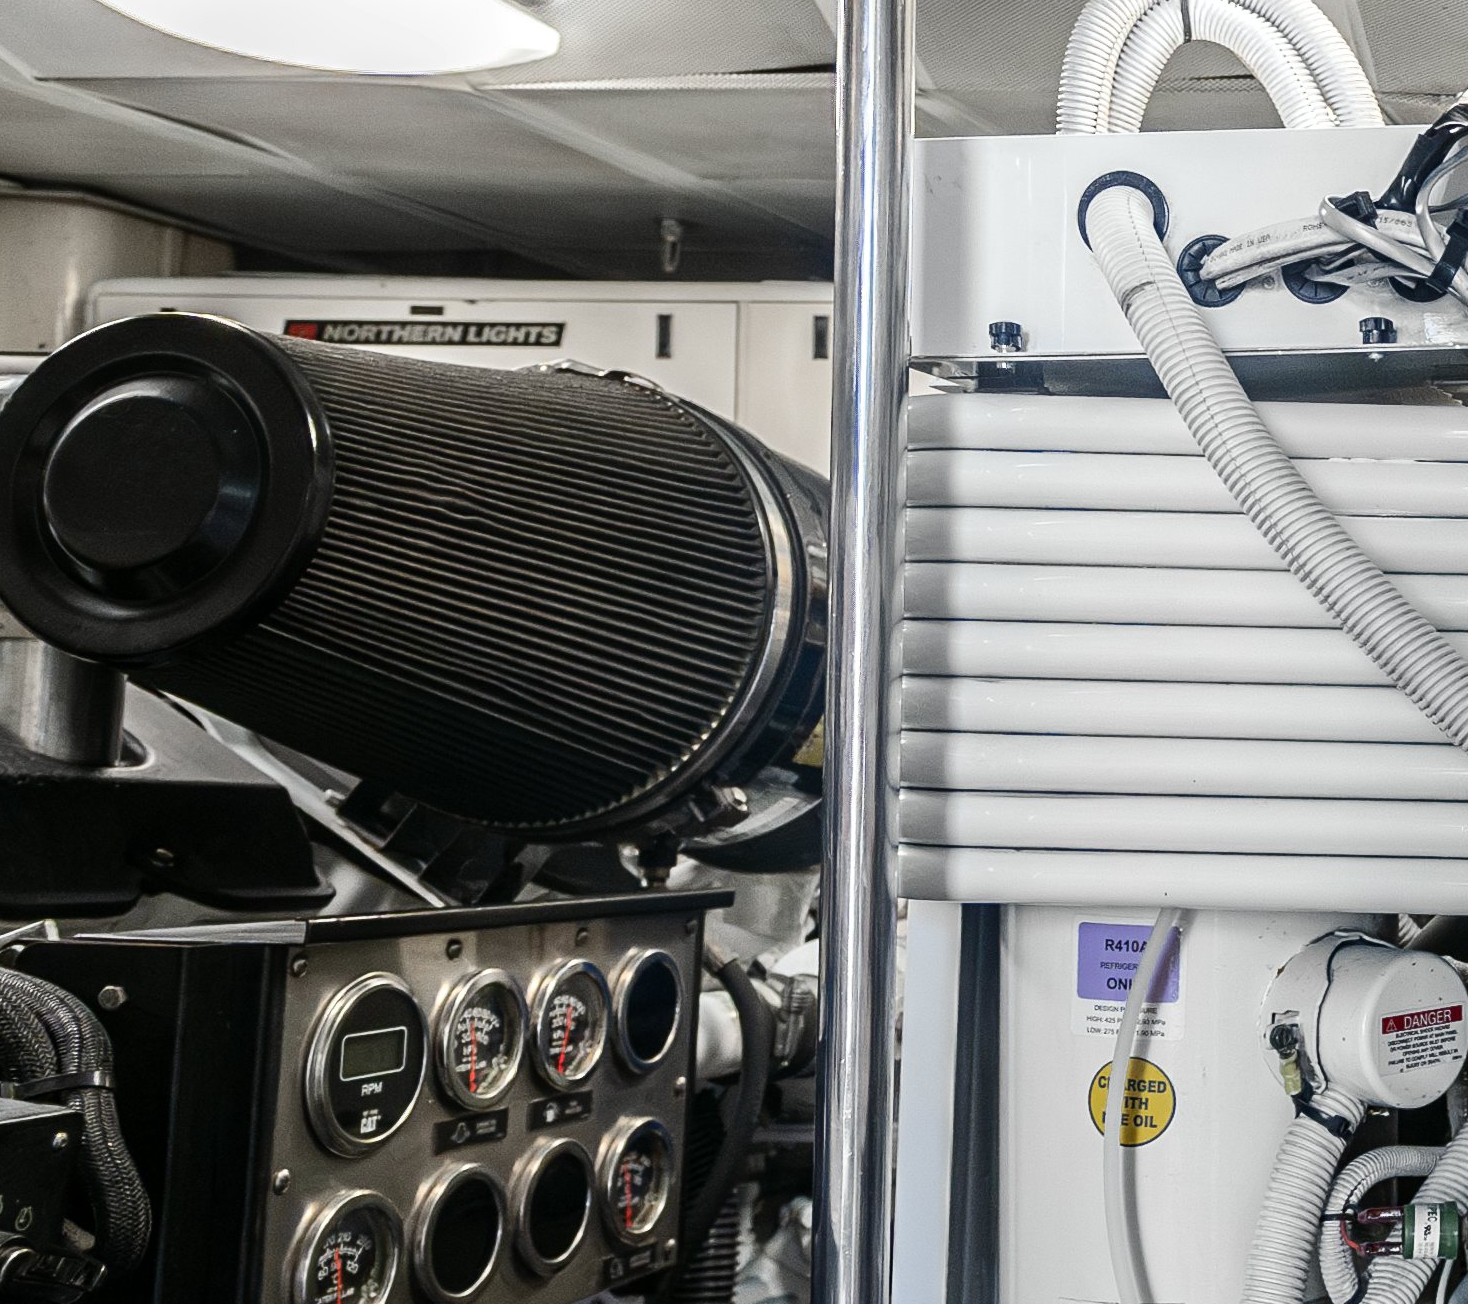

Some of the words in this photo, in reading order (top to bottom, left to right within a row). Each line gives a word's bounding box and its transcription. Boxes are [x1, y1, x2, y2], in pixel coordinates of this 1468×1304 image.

[323, 324, 464, 343] NORTHERN
[467, 324, 559, 343] LIGHTS
[1404, 1009, 1452, 1030] DANGER
[361, 1082, 382, 1097] RPM
[1098, 1076, 1167, 1093] CRGED
[1123, 1096, 1149, 1110] ITH
[1133, 1115, 1158, 1128] OIL
